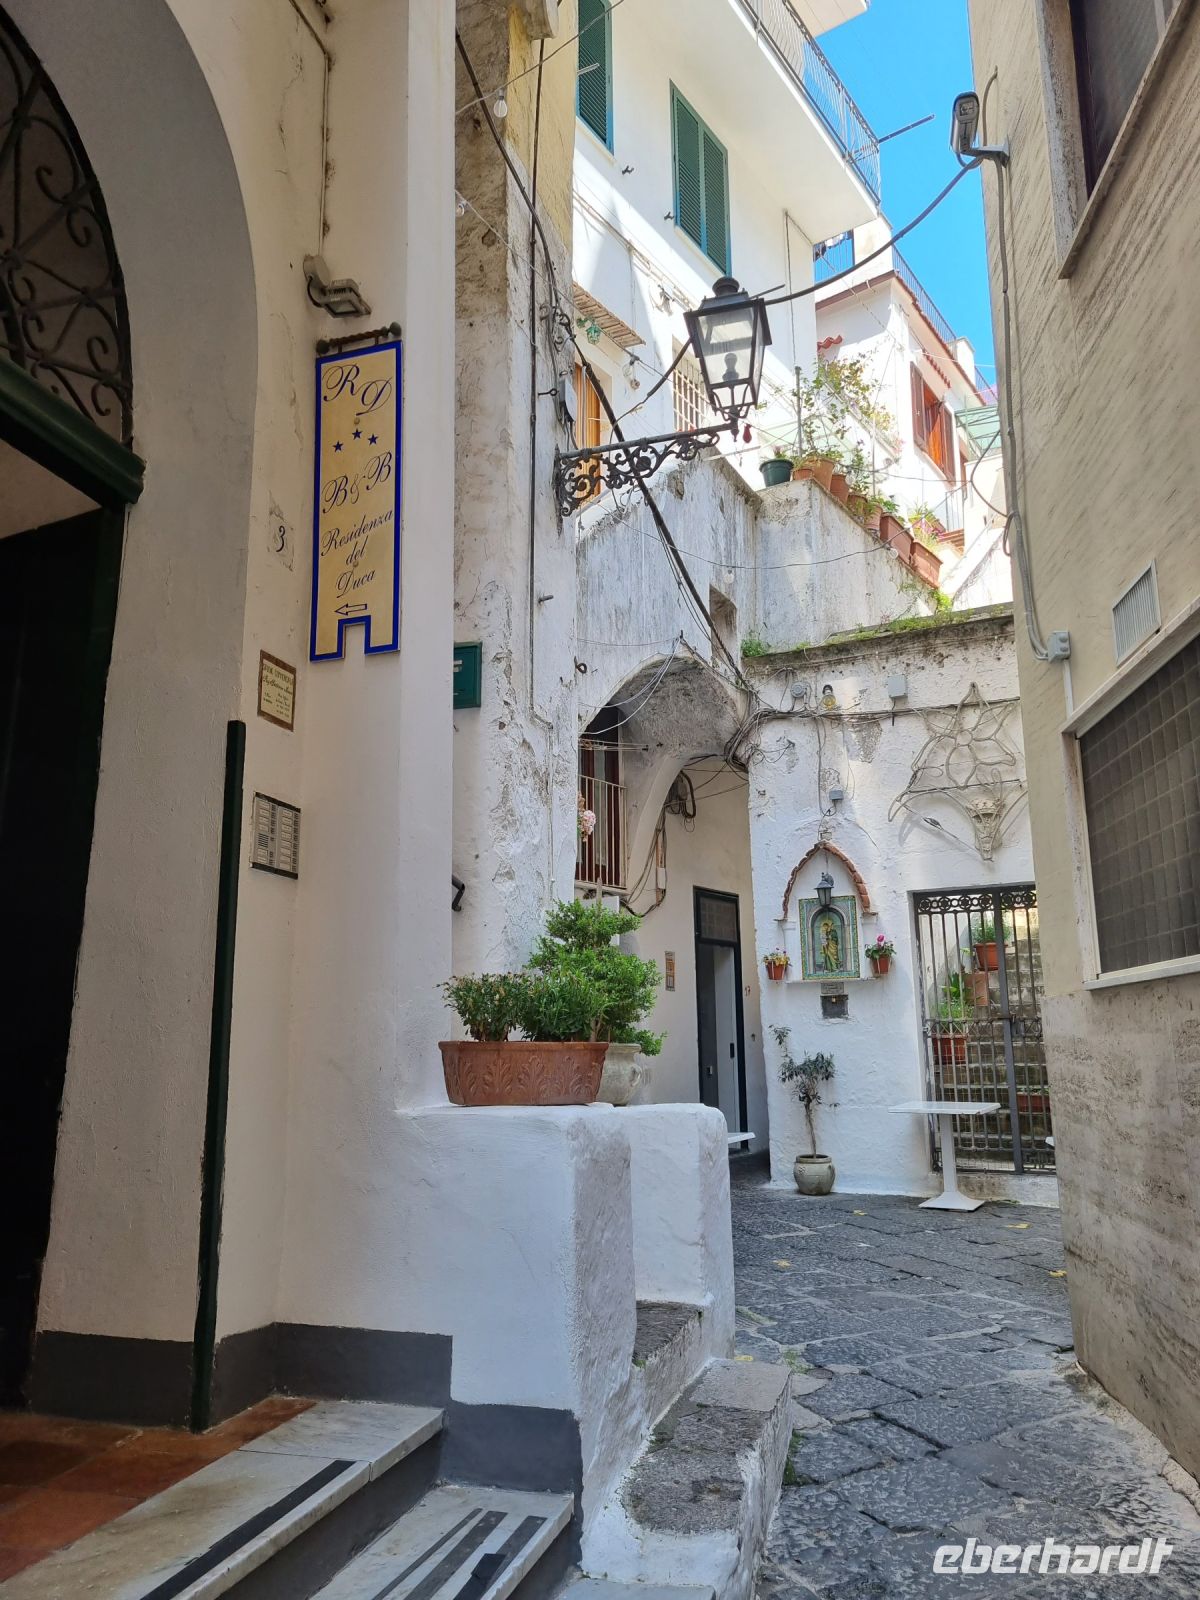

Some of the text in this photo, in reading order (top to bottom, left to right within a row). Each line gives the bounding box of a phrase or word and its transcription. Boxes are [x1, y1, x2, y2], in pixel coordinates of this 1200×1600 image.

[322, 450, 392, 513] B&B
[275, 525, 286, 553] 3
[321, 510, 393, 556] Residenza
[346, 535, 369, 566] del
[336, 568, 376, 598] Duca
